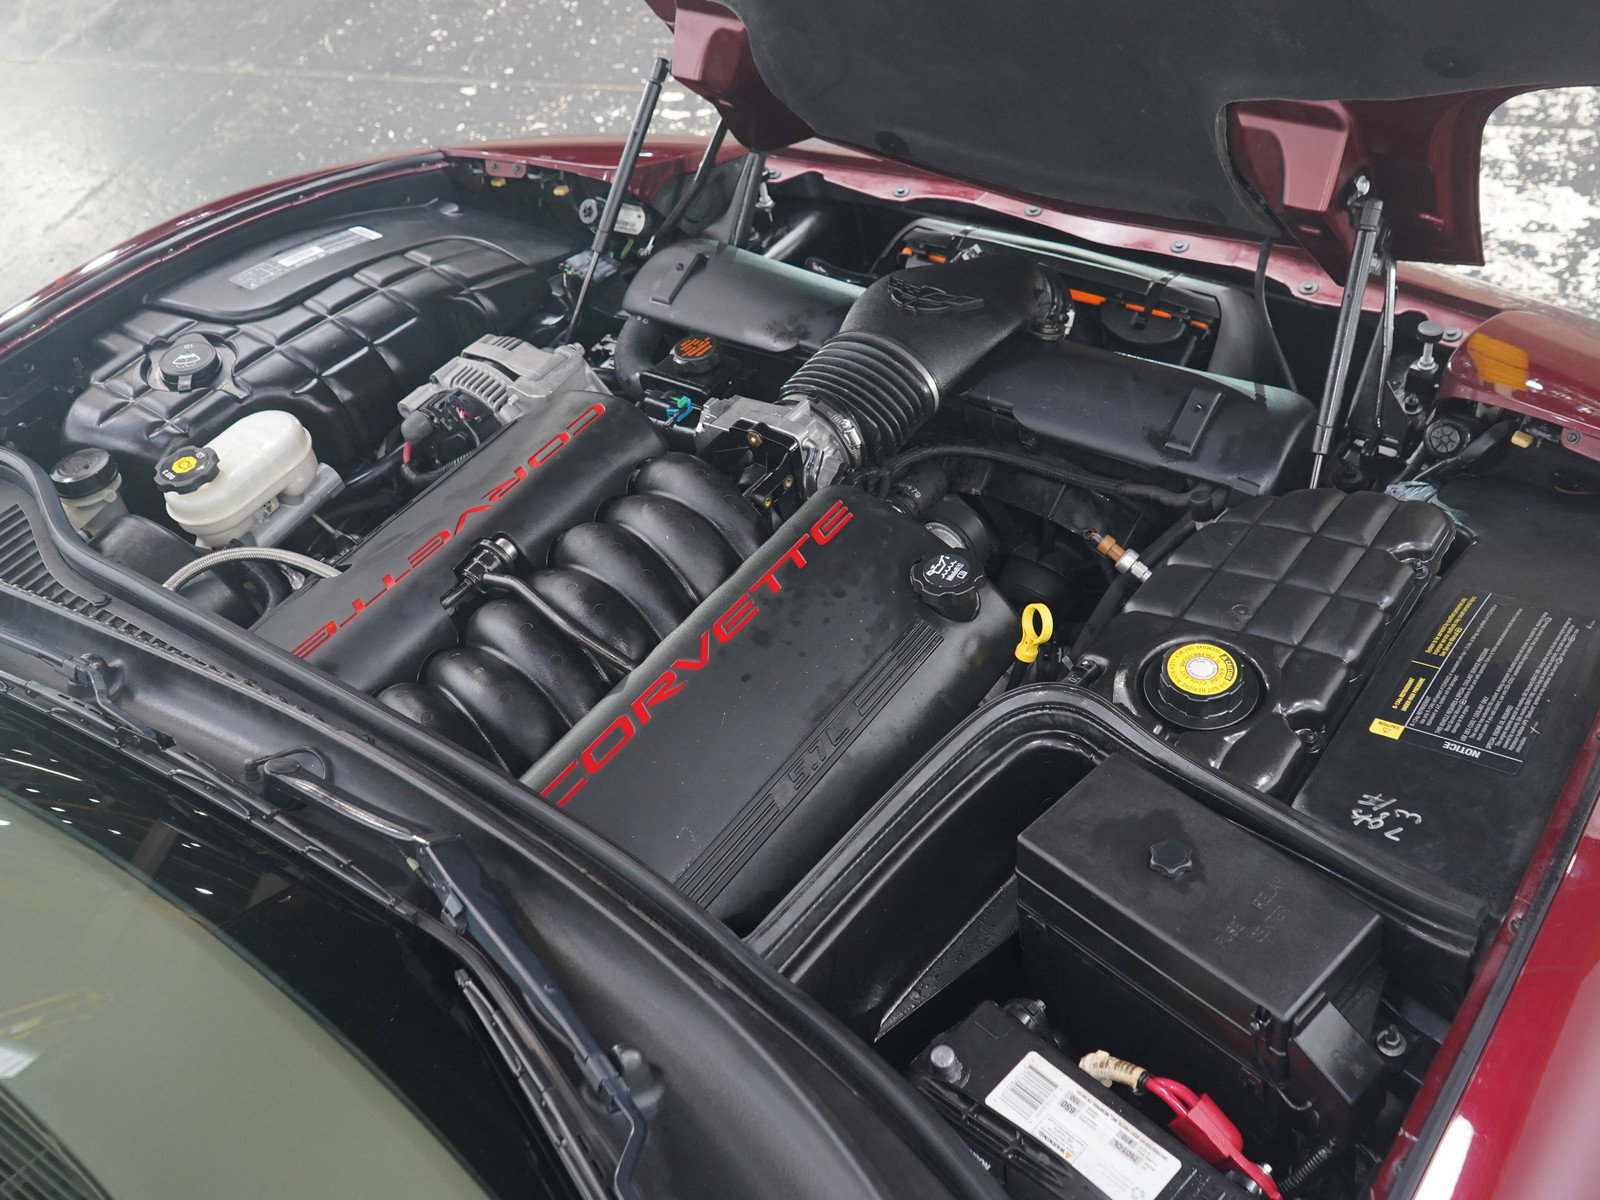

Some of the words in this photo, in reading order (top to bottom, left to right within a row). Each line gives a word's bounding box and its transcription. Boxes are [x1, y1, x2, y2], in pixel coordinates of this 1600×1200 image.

[292, 404, 604, 658] CORVETTE
[540, 501, 853, 807] CORVETTE
[1441, 740, 1481, 759] NOTICE
[1059, 1099, 1076, 1114] 650
